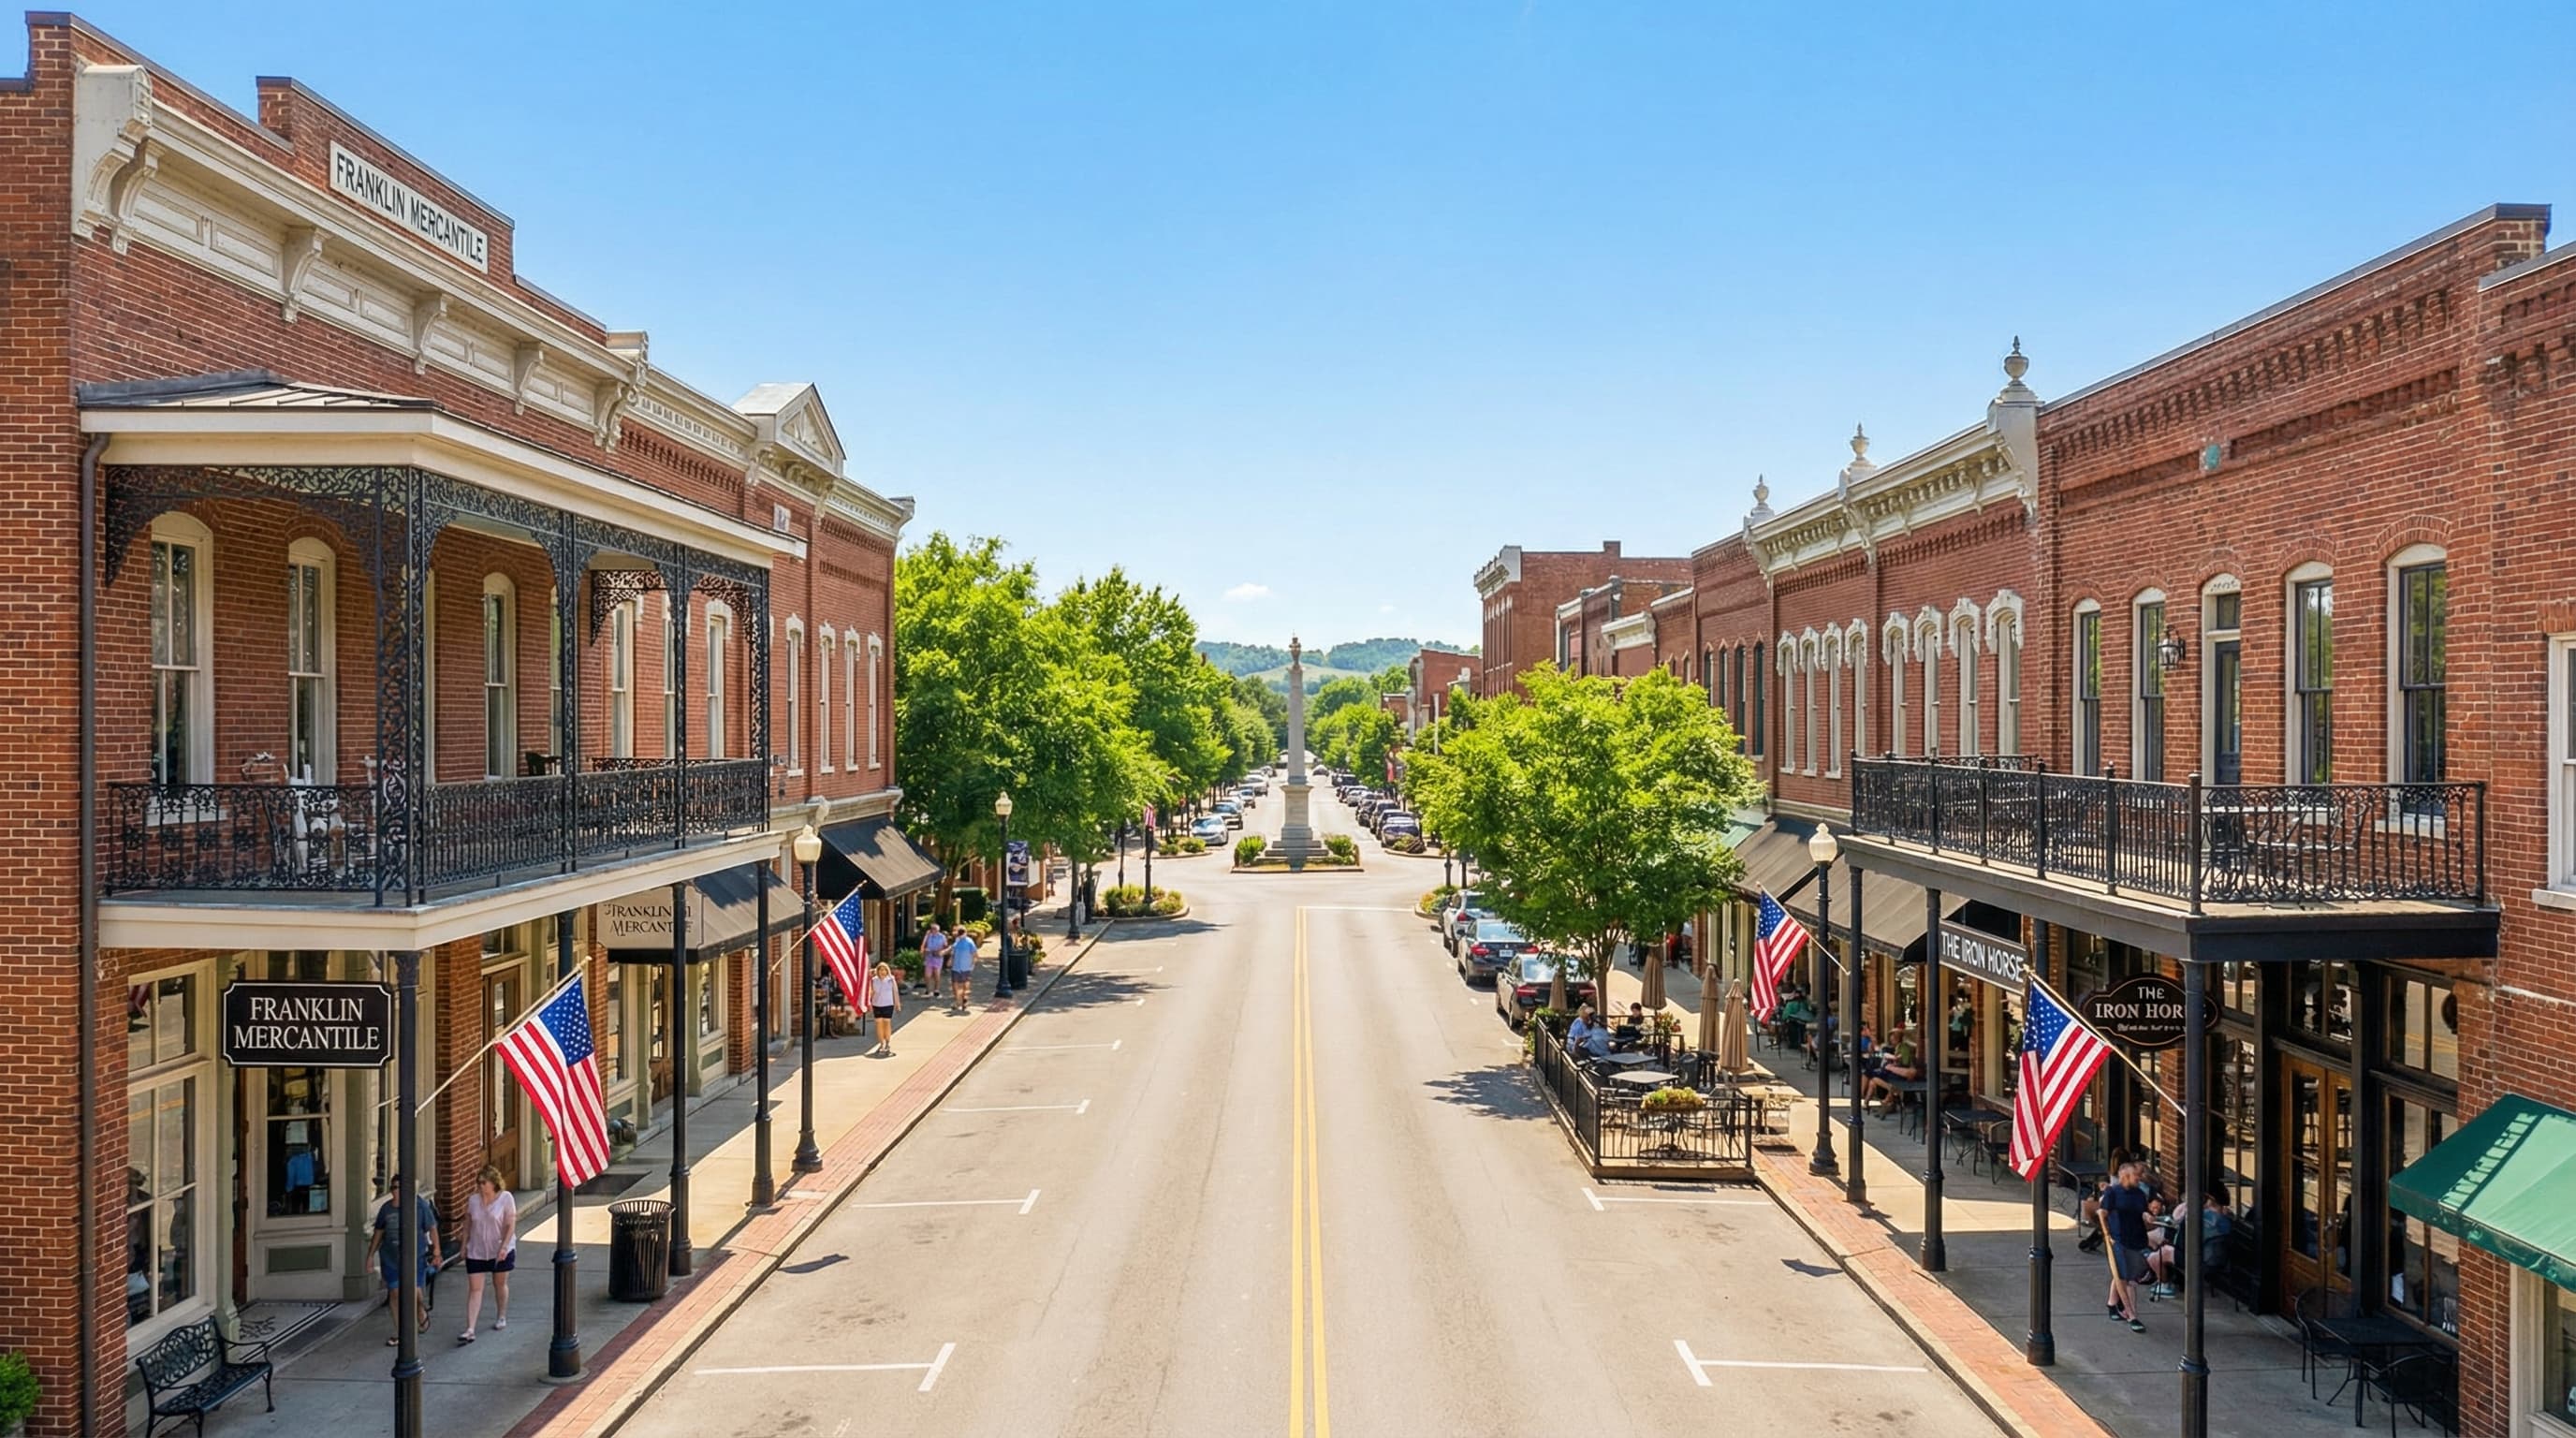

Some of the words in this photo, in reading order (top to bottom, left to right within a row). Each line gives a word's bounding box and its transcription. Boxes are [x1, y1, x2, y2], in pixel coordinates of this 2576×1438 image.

[337, 152, 404, 220] FRANKLIN
[410, 196, 483, 265] MERCANTILE
[609, 920, 693, 936] MERCANTE
[1940, 931, 1960, 960] THE
[1961, 936, 1985, 969] IRON
[1987, 945, 2024, 983] HORSE
[2137, 986, 2165, 1000] THE
[250, 997, 364, 1021] FRANKLIN
[2095, 1003, 2140, 1019] IRON
[2144, 1003, 2207, 1019] HOR
[234, 1025, 380, 1049] MERCANTILE
